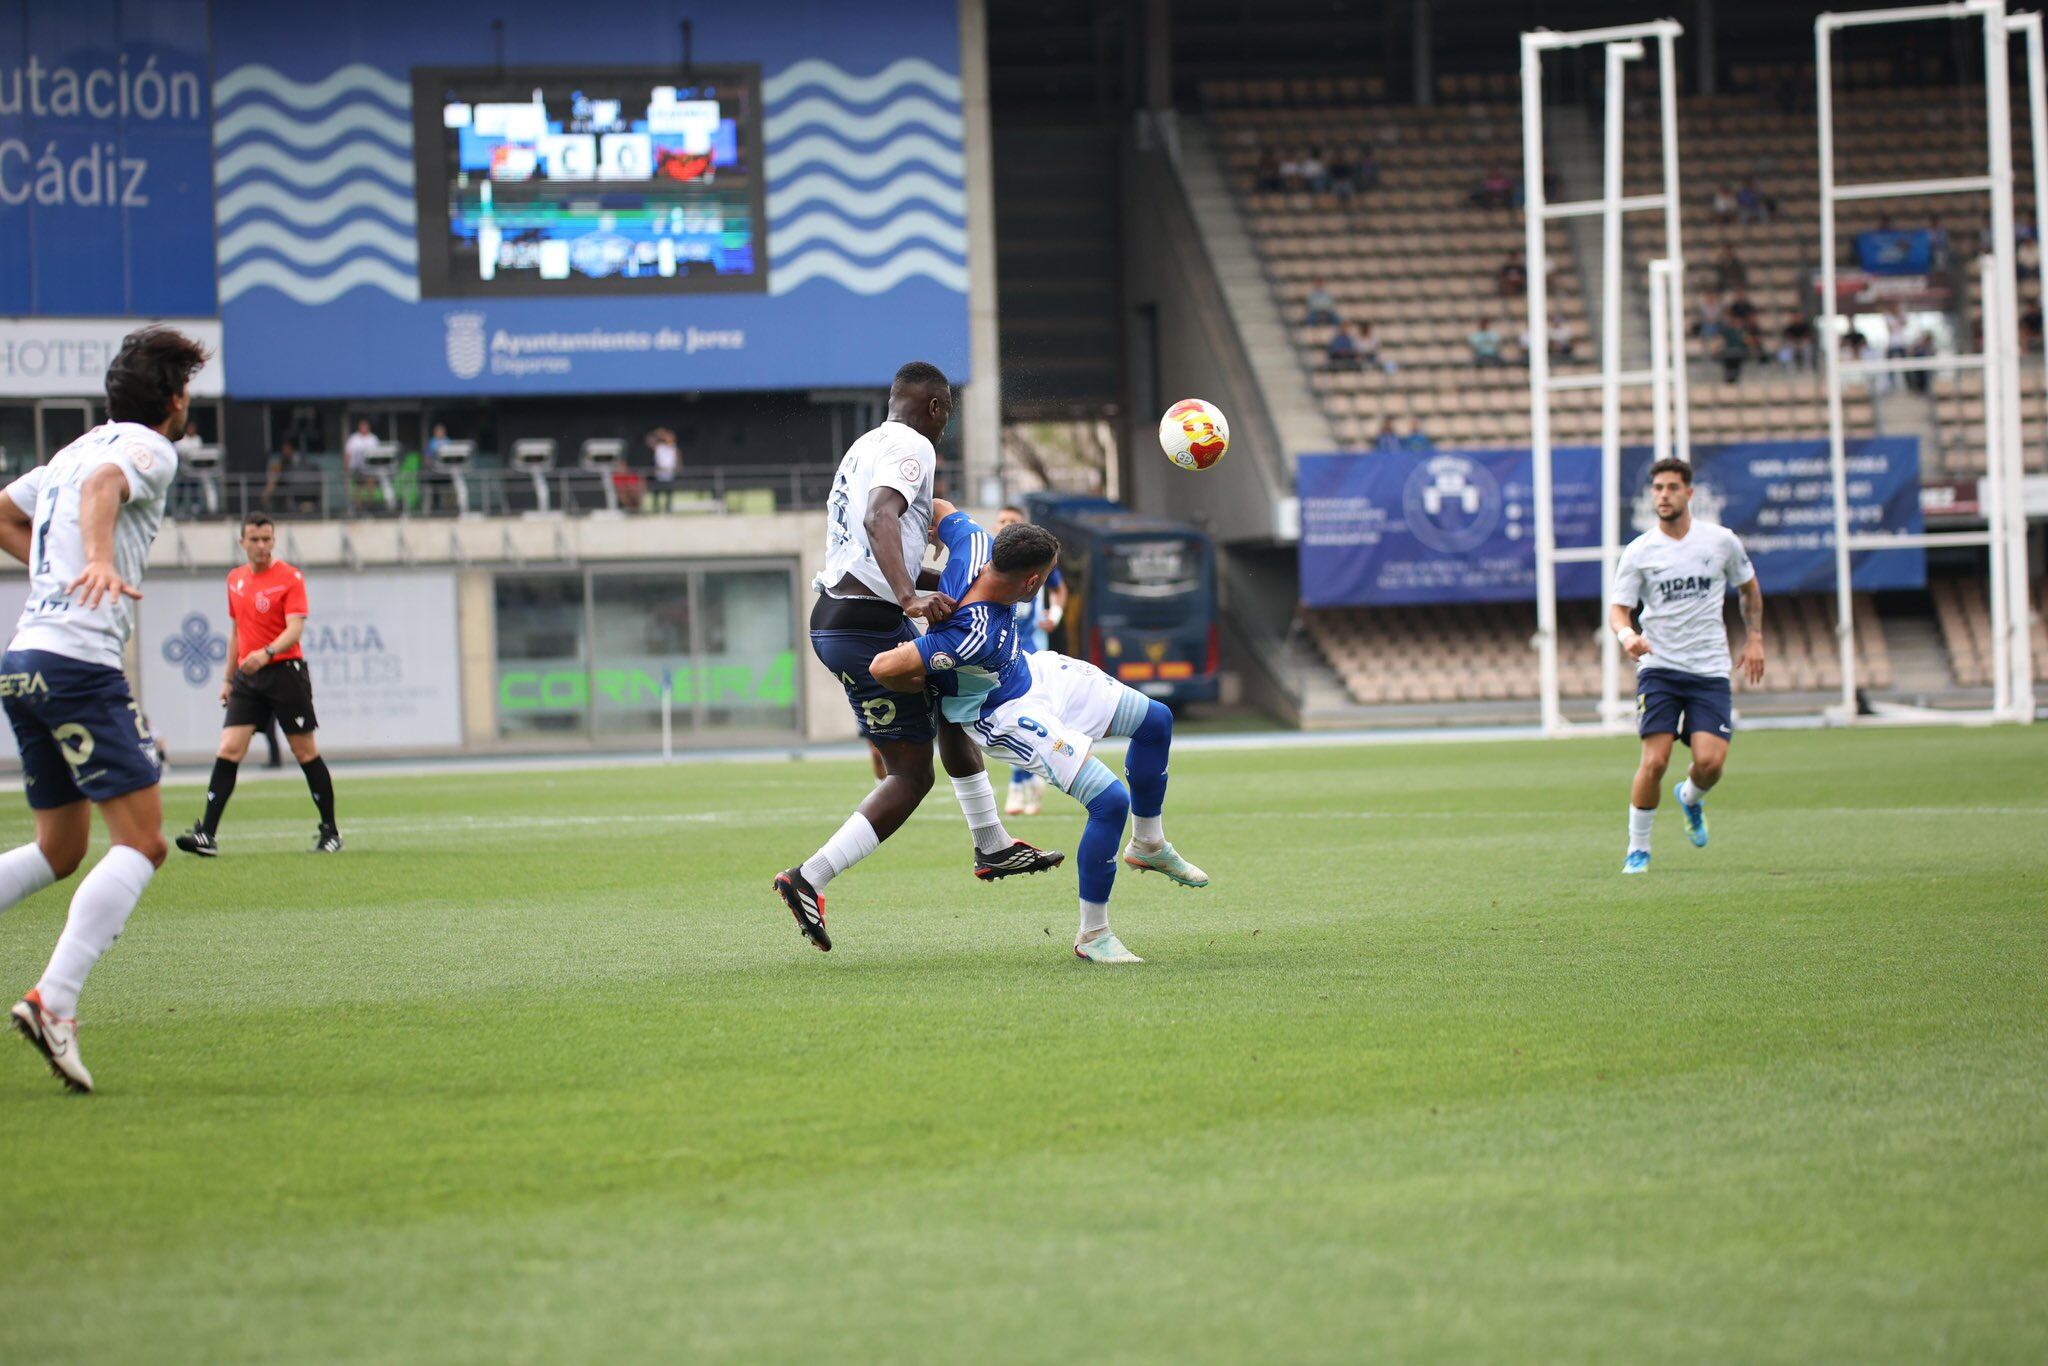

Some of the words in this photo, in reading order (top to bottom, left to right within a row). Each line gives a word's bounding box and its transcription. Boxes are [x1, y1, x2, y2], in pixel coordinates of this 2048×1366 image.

[0, 138, 148, 206] Cádiz
[491, 329, 651, 357] Ayuntamiento
[654, 327, 684, 350] de
[685, 325, 745, 354] Jerez
[1017, 716, 1049, 738] 9
